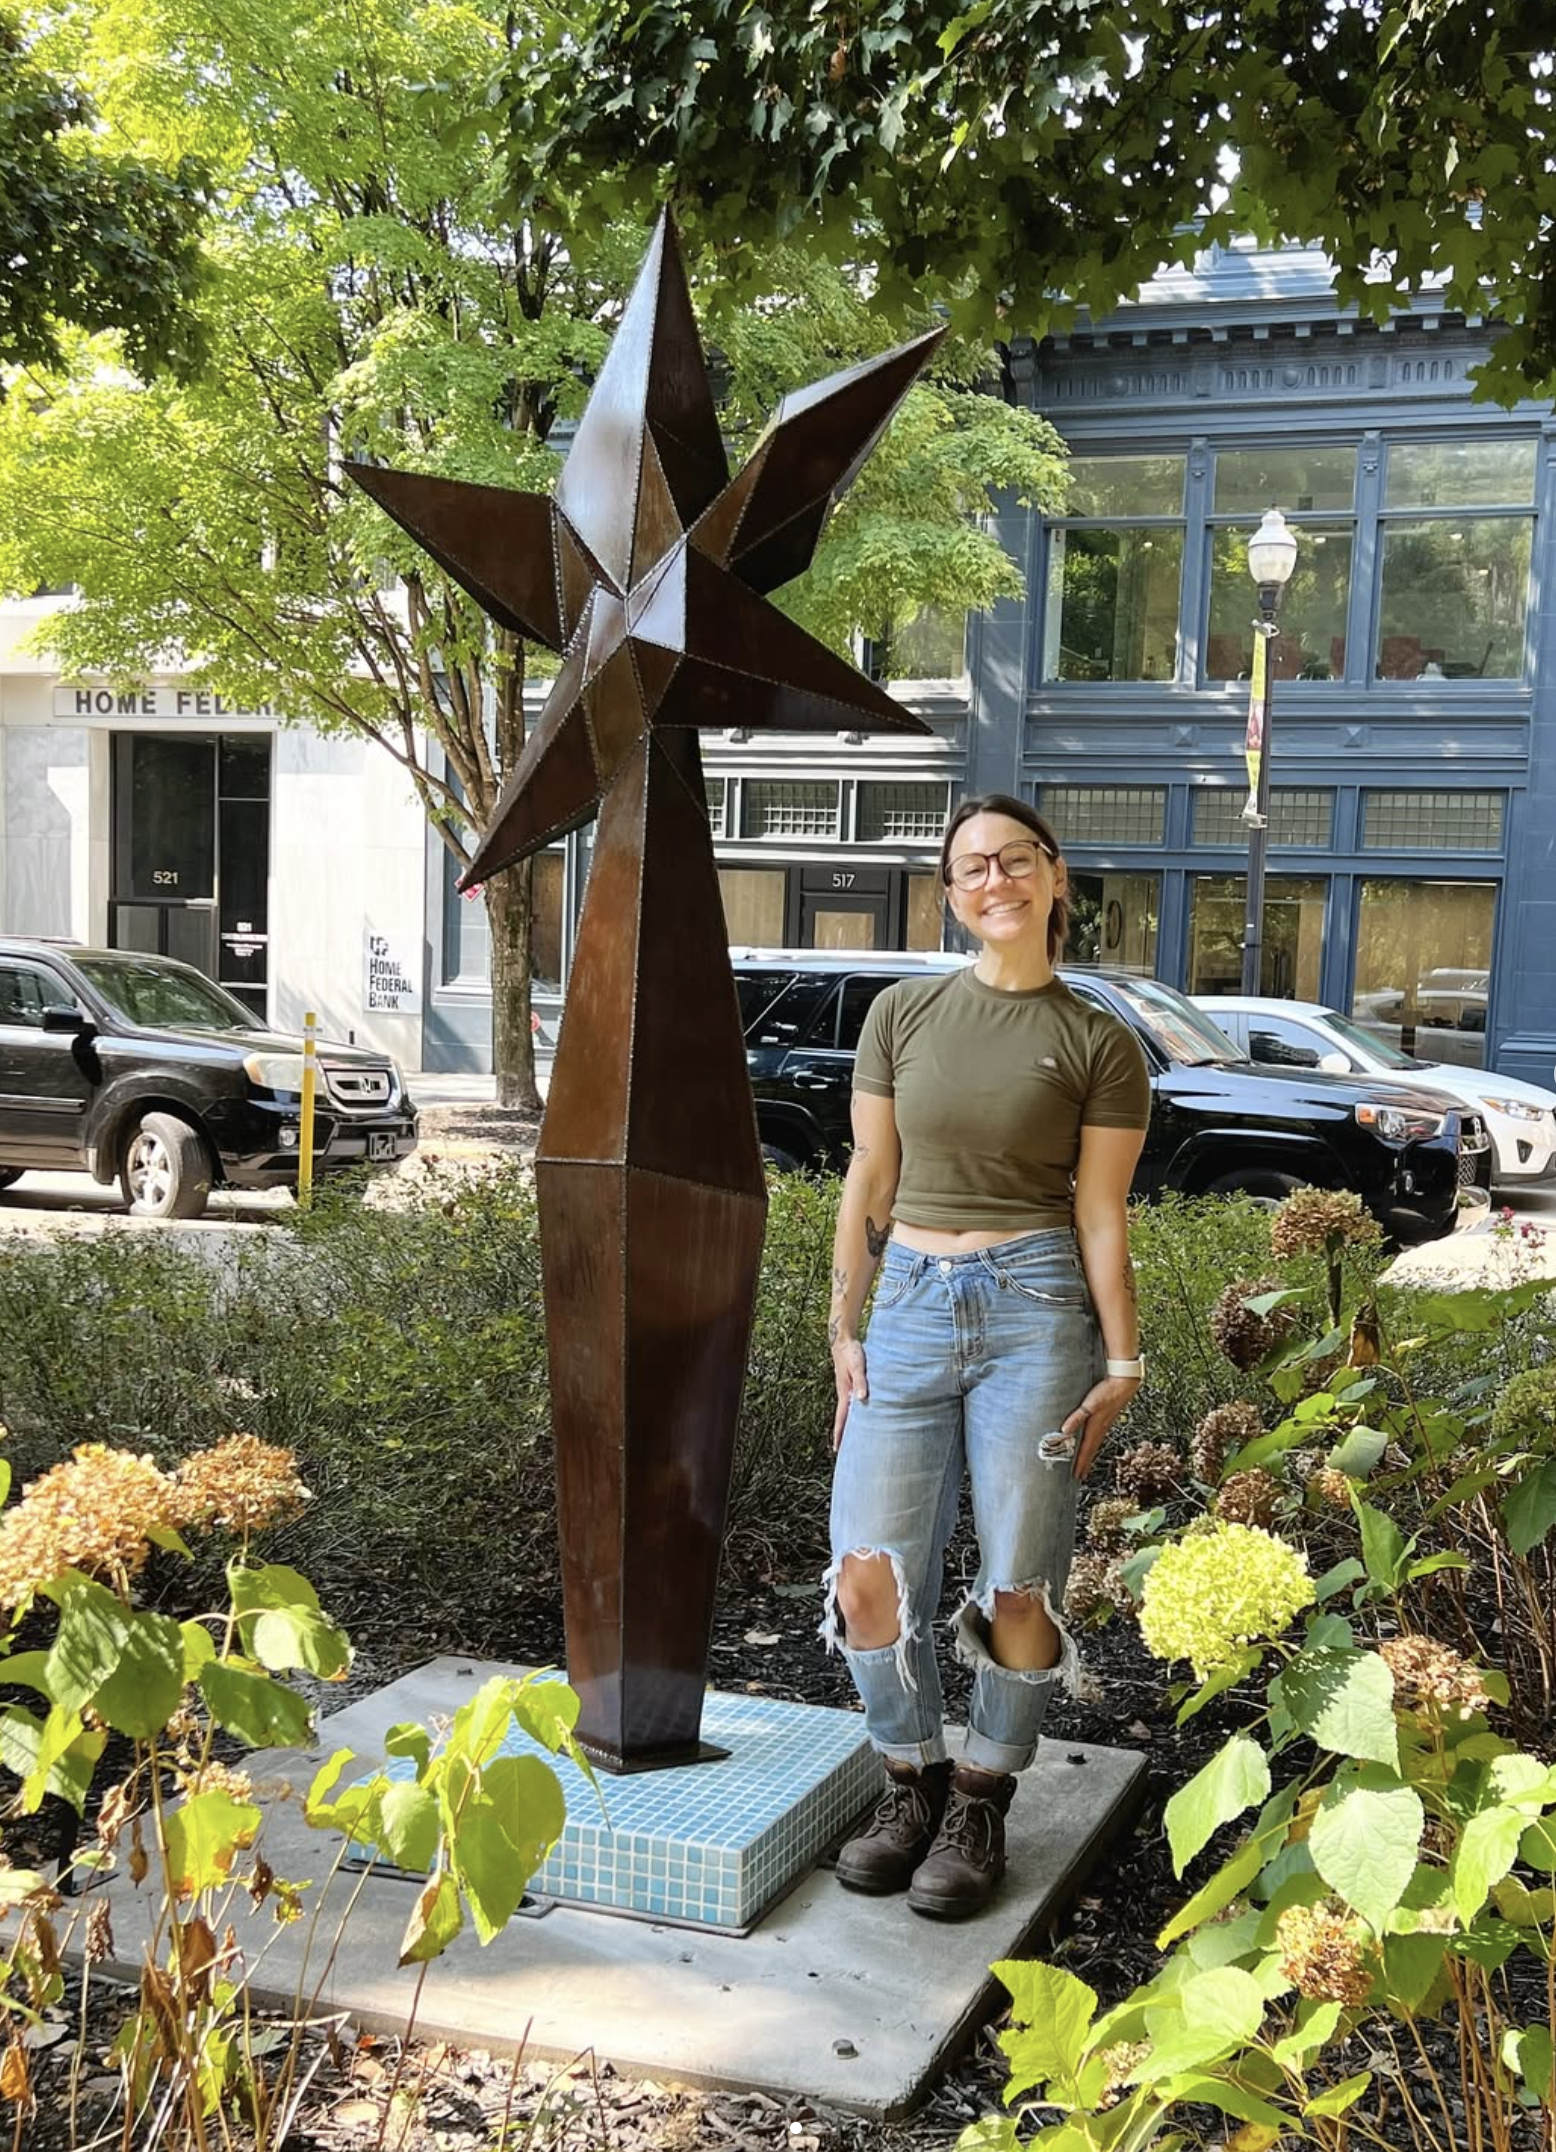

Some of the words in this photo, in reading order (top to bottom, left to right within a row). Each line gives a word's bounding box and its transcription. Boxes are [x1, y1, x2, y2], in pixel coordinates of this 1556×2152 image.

[75, 690, 157, 714] HOME
[152, 870, 179, 885] 521
[832, 873, 855, 888] 517
[369, 957, 401, 976] HOME
[369, 974, 413, 993] FEDERAL
[369, 991, 399, 1009] BANK
